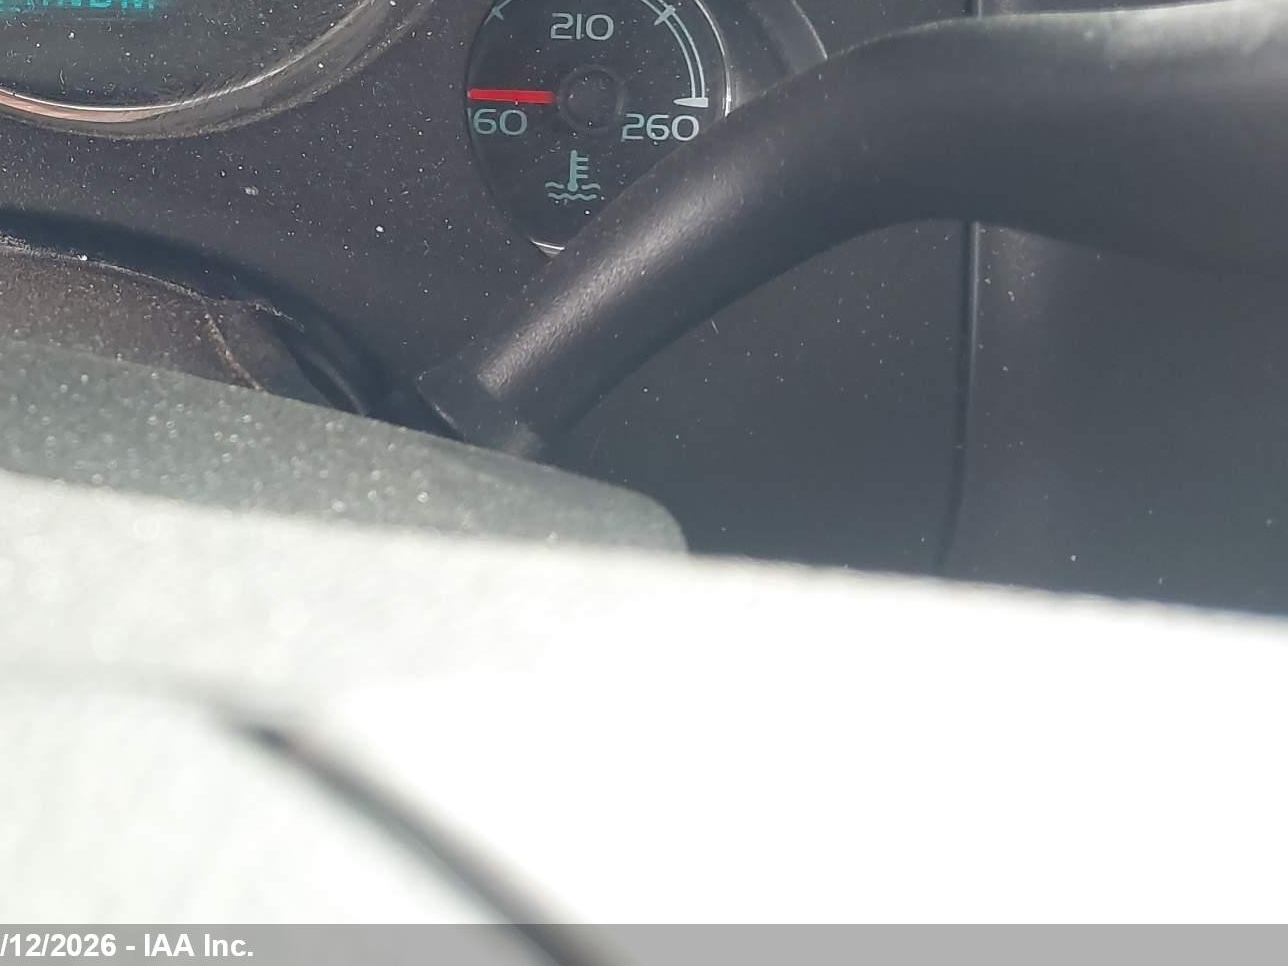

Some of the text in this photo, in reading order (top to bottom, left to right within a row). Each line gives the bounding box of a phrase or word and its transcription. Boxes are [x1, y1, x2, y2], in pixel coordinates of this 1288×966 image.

[550, 13, 614, 41] 210
[473, 109, 528, 136] 60
[622, 114, 700, 141] 260
